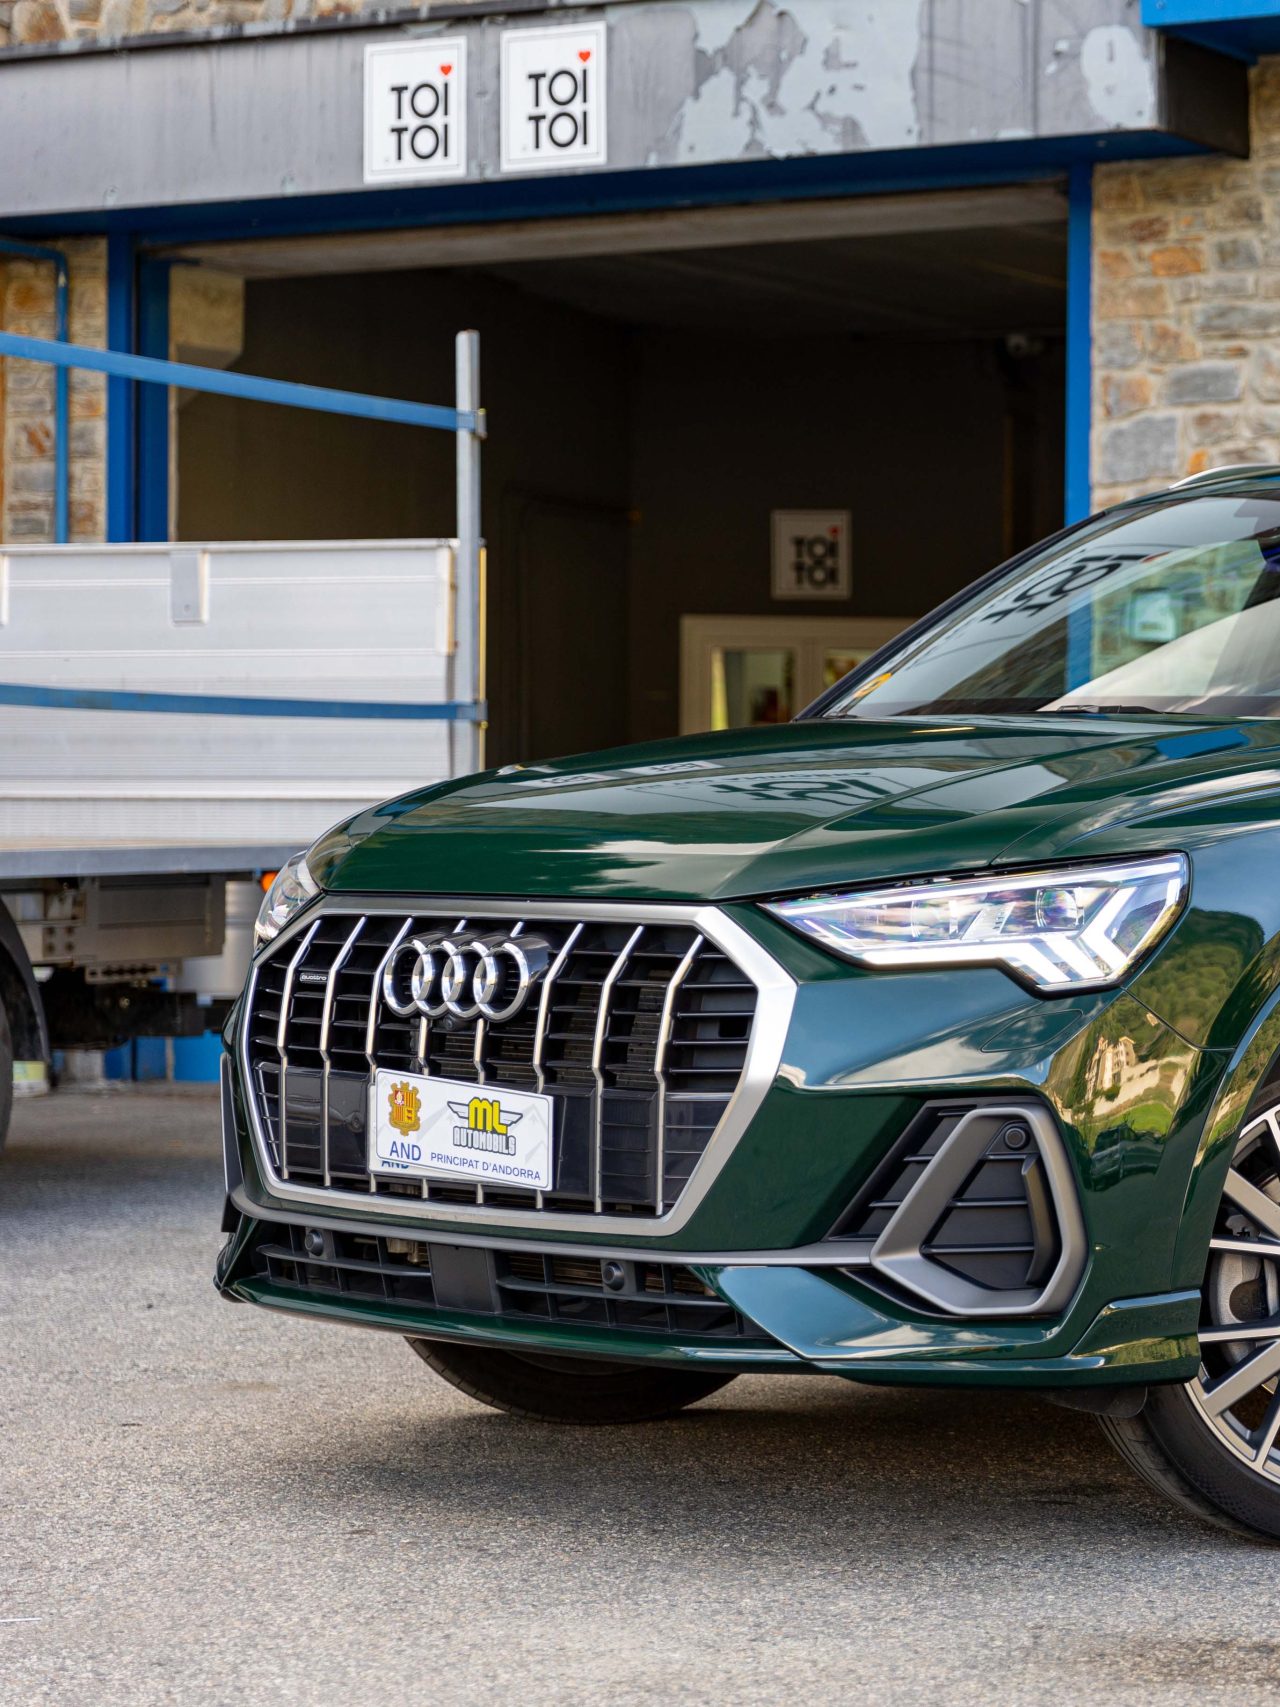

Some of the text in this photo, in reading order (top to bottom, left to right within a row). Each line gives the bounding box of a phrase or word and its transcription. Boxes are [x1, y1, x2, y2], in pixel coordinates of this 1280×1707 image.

[390, 82, 448, 120] TOI
[528, 68, 587, 108] TOI
[390, 123, 448, 161] TOI
[528, 110, 587, 149] TOI
[790, 536, 838, 562] TOI
[790, 561, 838, 589] TOI
[468, 1096, 508, 1135] ML
[389, 1140, 422, 1162] AND
[430, 1152, 480, 1170] PRINCIPAT
[482, 1160, 541, 1181] D'ANDORRA
